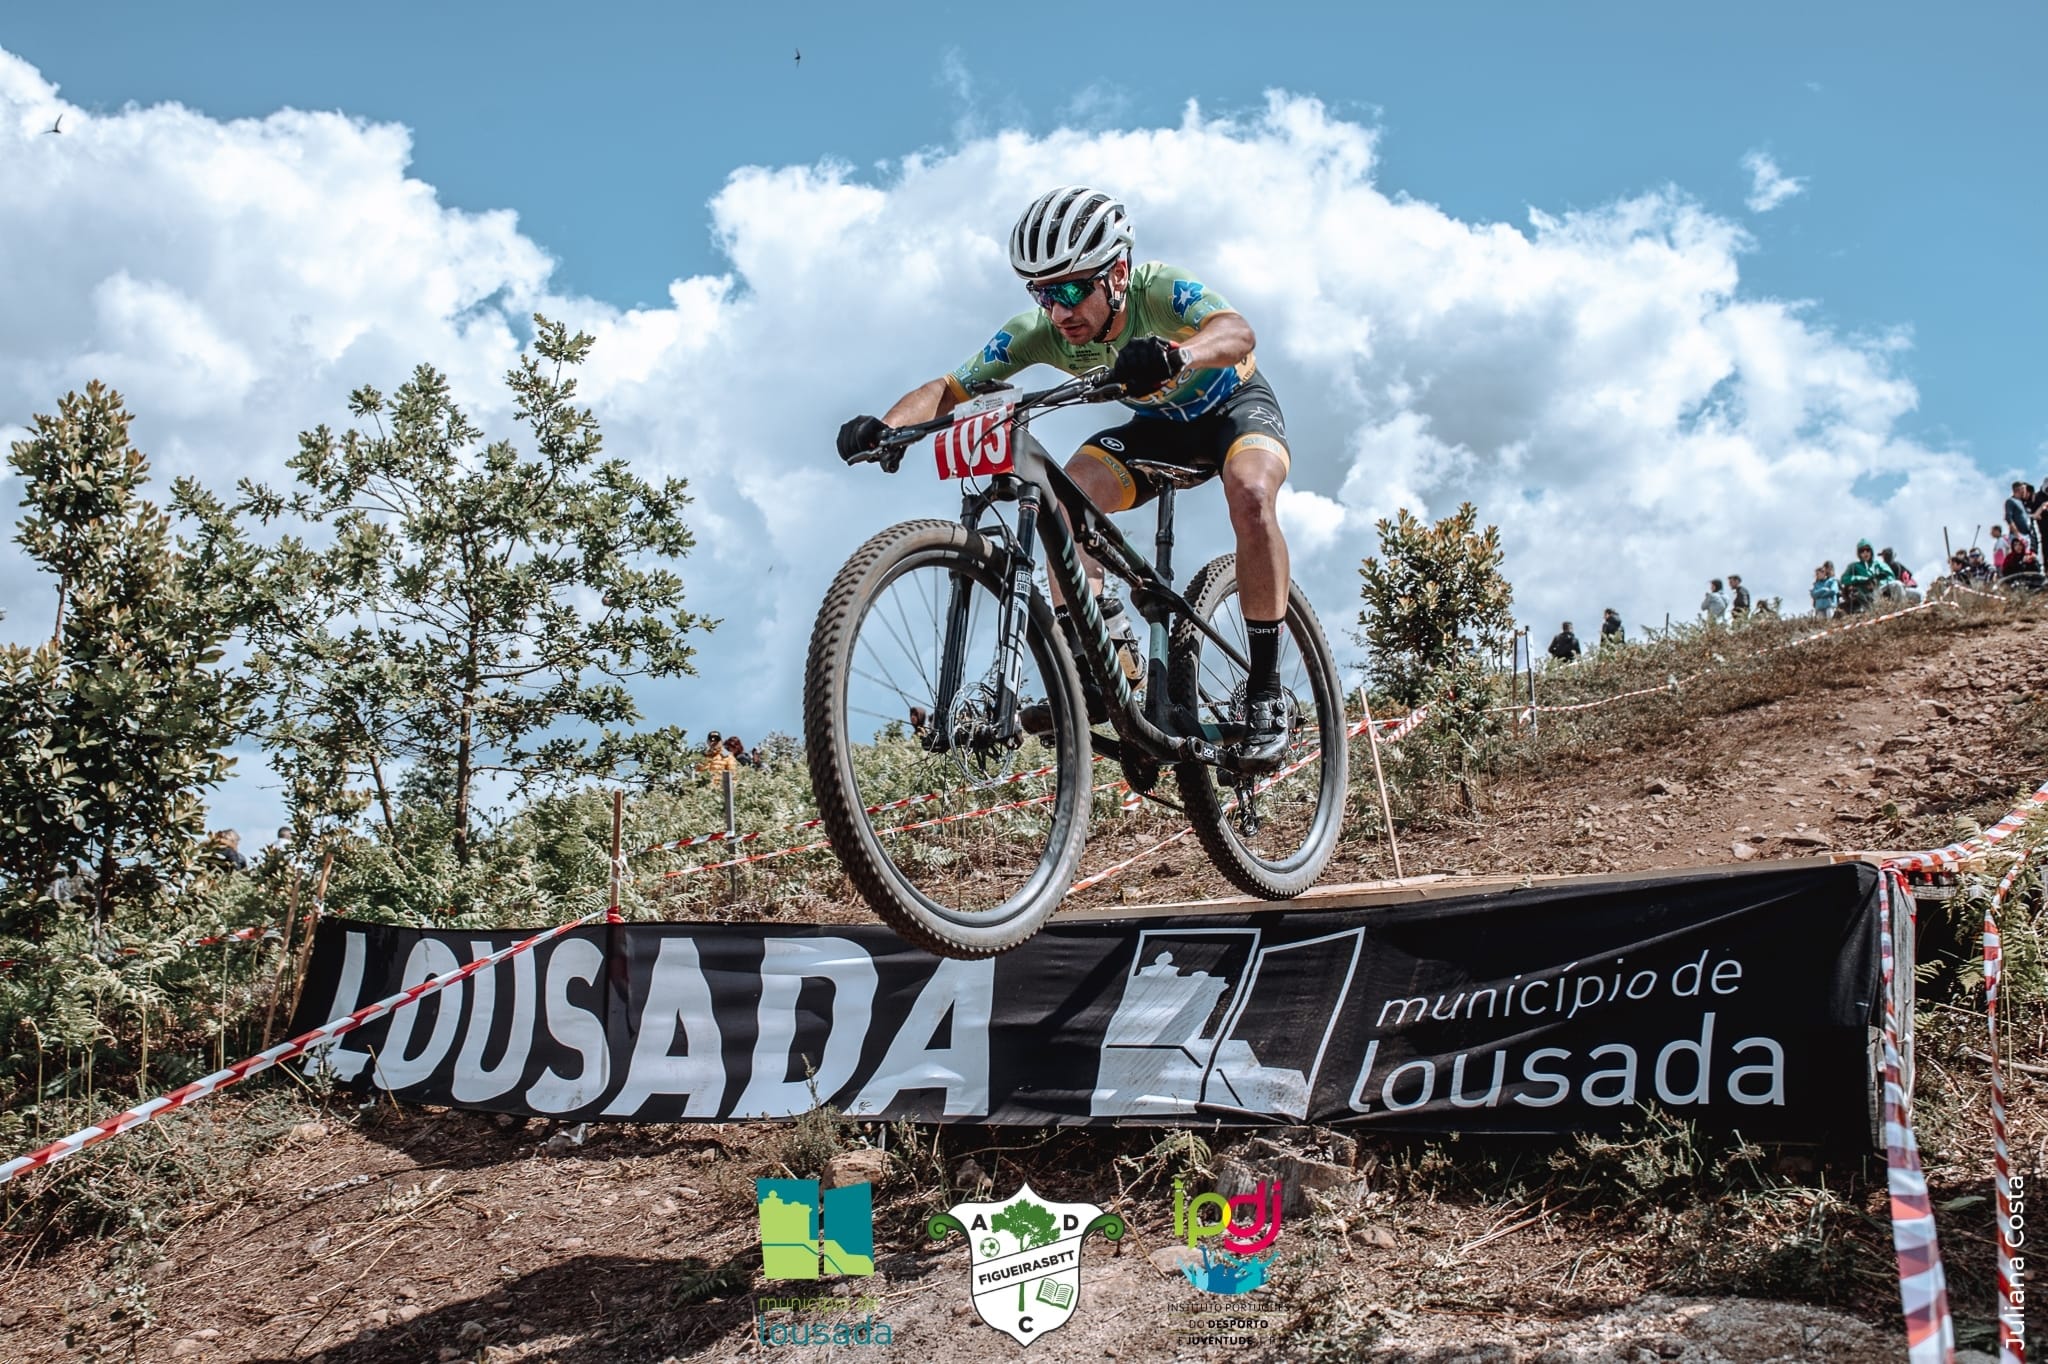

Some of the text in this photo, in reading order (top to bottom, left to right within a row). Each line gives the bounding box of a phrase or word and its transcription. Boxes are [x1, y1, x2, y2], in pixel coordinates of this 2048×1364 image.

[303, 931, 996, 1118] LOUSADA
[1375, 949, 1743, 1027] município de
[1348, 1012, 1786, 1113] lousada
